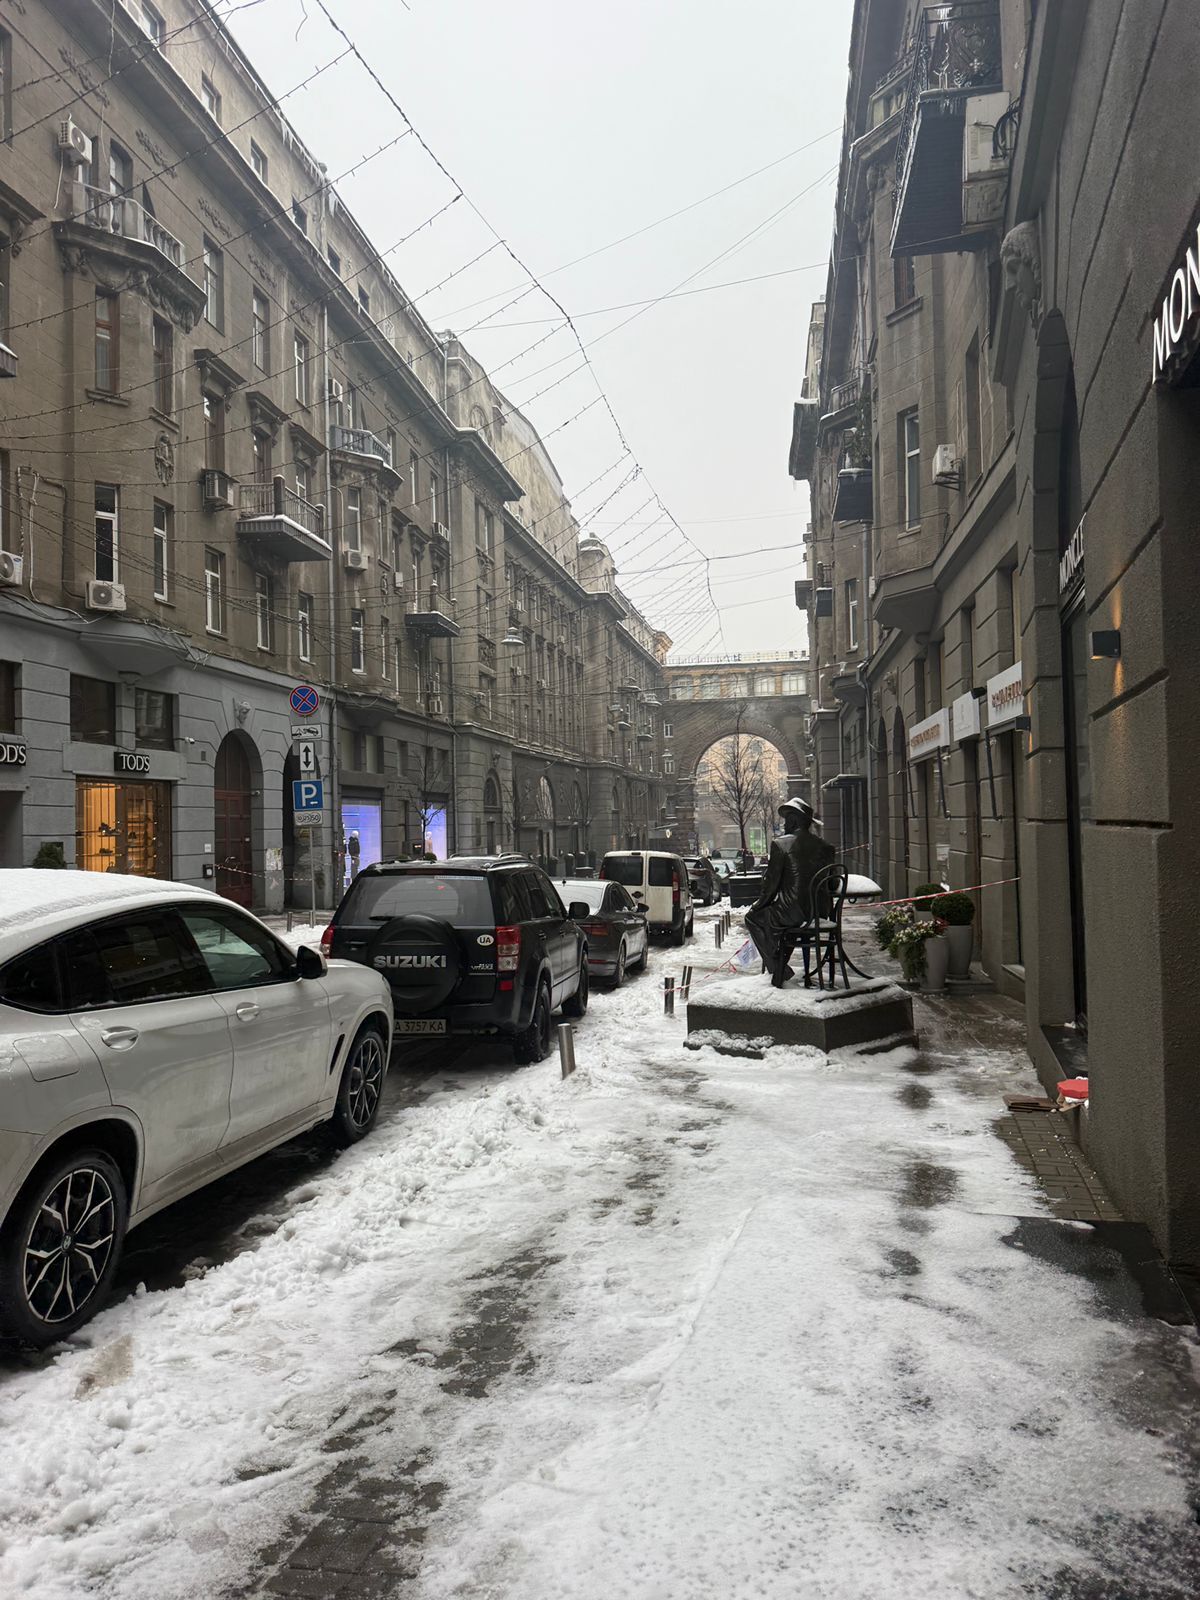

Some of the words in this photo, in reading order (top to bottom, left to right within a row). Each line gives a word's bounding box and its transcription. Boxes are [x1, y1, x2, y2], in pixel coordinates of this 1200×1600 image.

[1152, 223, 1200, 384] MON
[120, 753, 150, 772] TOD'S
[301, 784, 316, 807] P
[479, 936, 492, 944] UA
[373, 955, 447, 968] SUZUKI
[403, 1021, 427, 1032] 3757
[430, 1021, 444, 1031] KA
